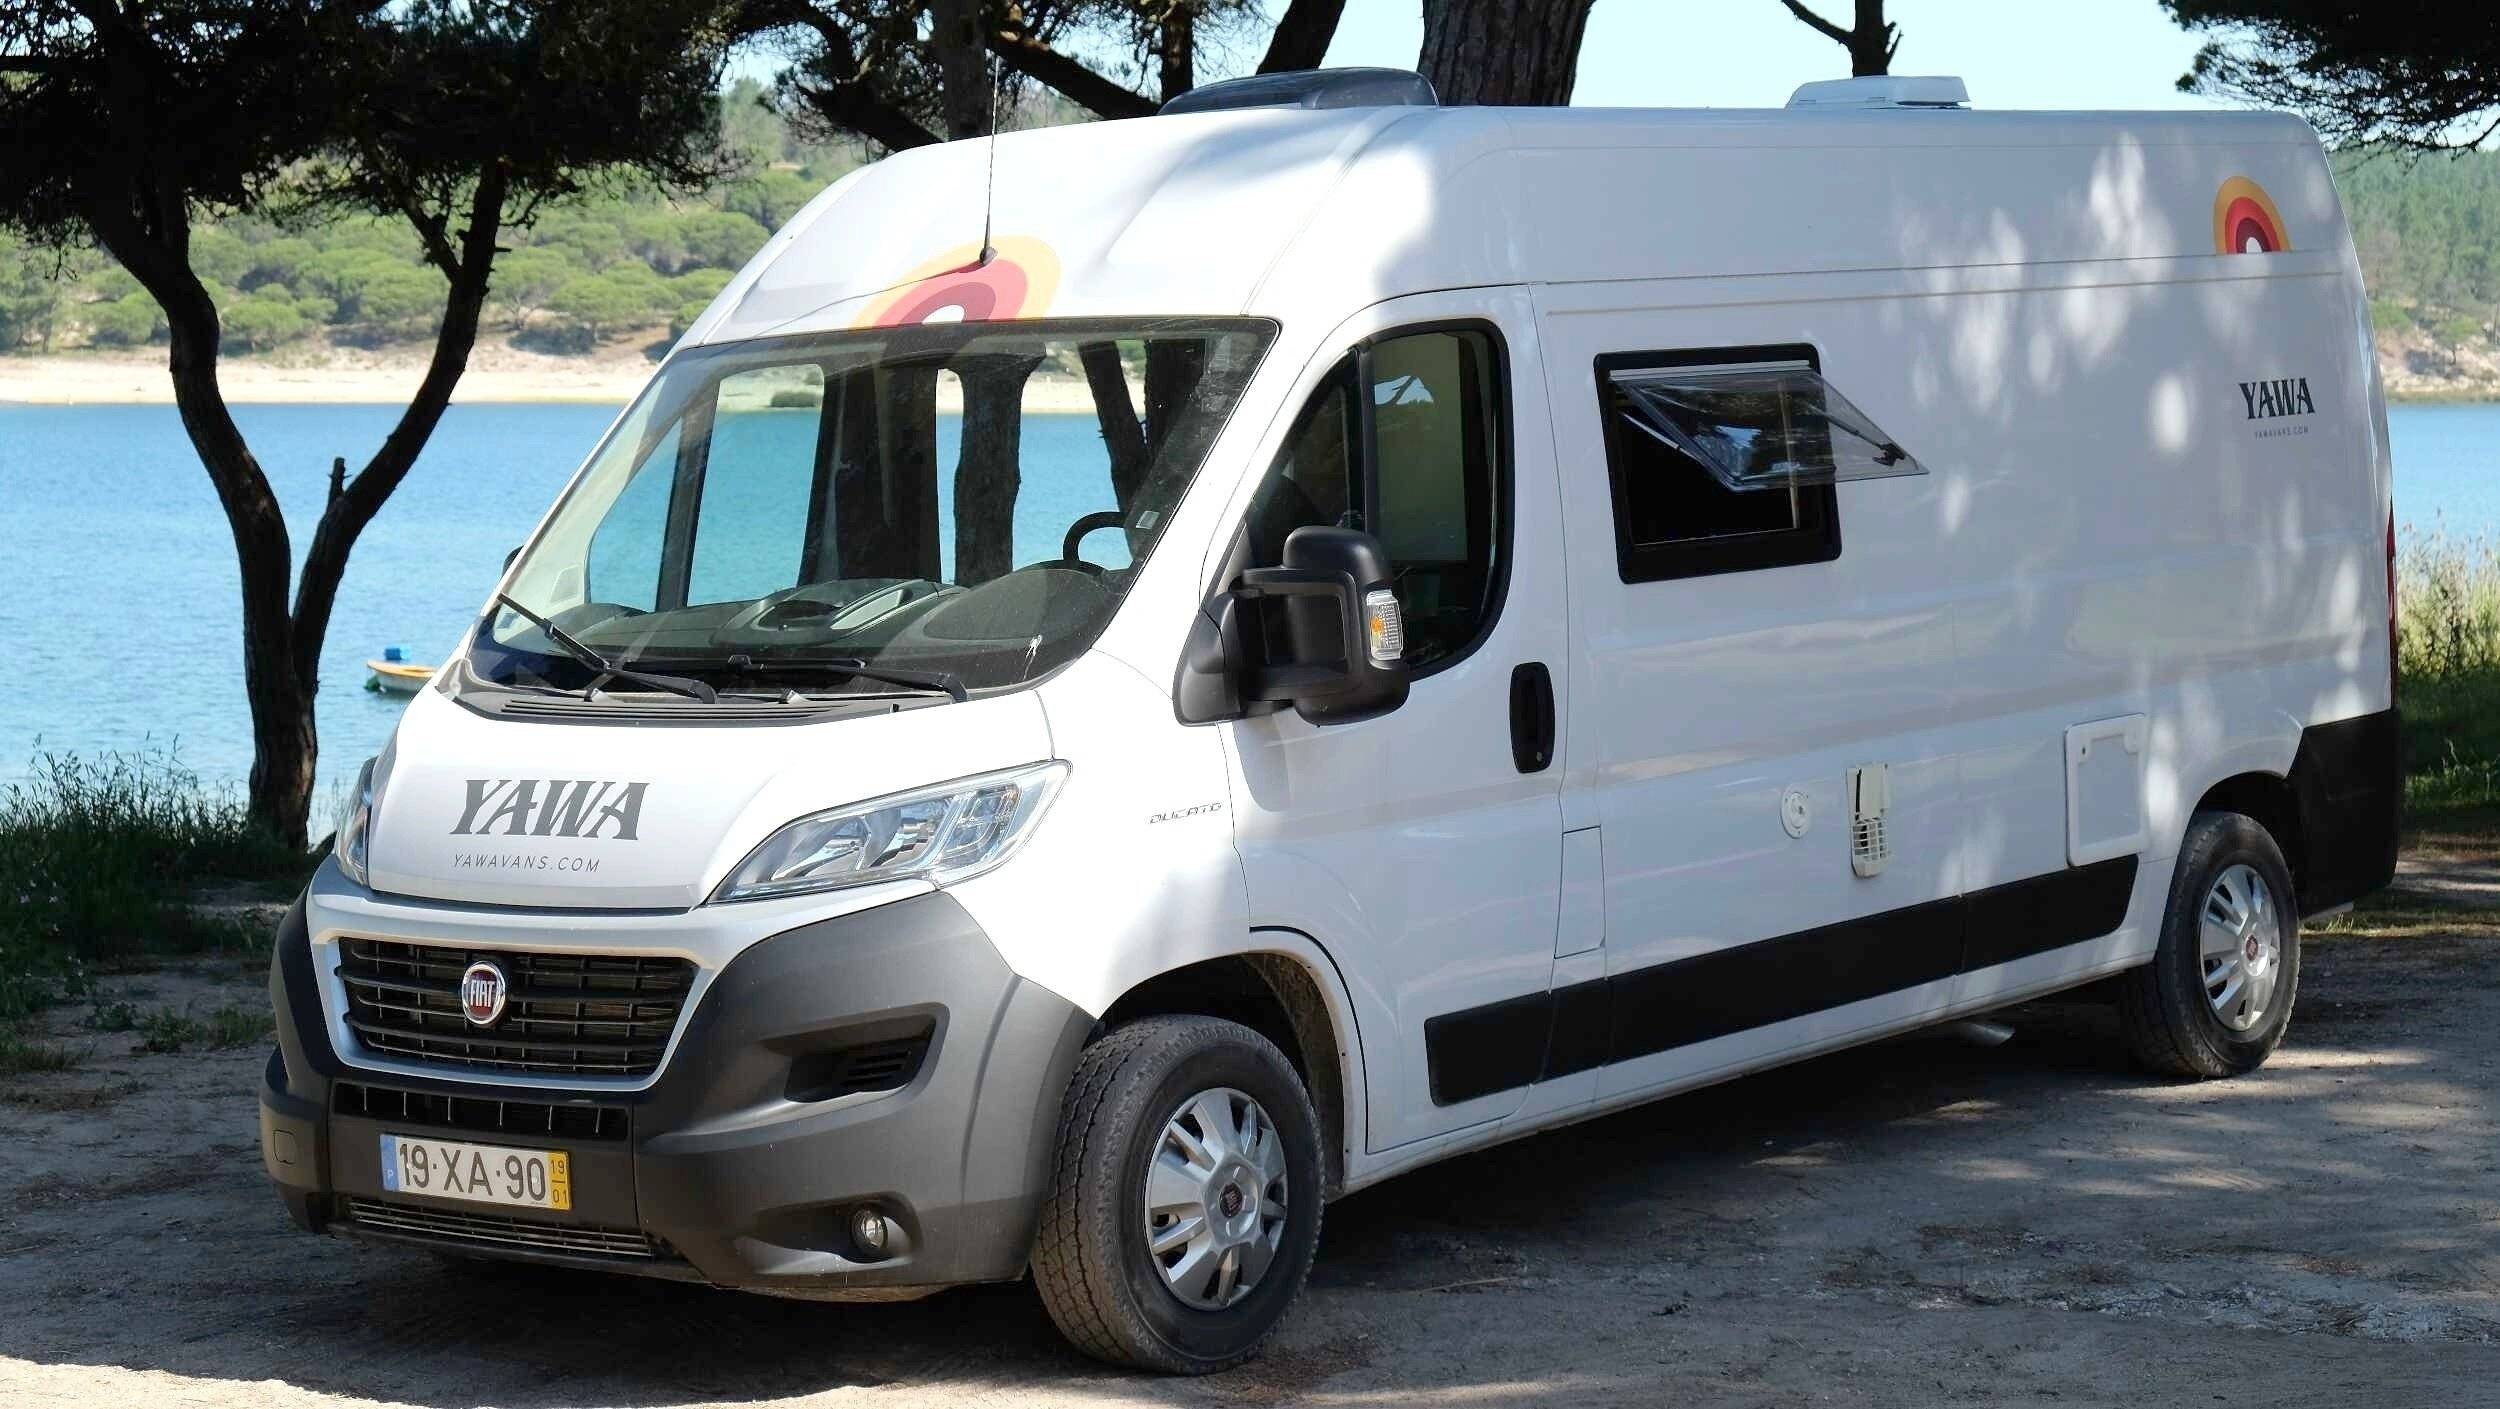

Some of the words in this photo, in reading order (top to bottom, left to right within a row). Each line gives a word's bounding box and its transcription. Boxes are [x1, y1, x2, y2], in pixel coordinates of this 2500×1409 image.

[2238, 375, 2315, 419] YAWA
[449, 779, 651, 841] YAWA
[453, 853, 601, 873] YAWAVANS.COM
[470, 979, 495, 1008] FIAT
[550, 1159, 565, 1175] 19
[552, 1189, 568, 1204] 01
